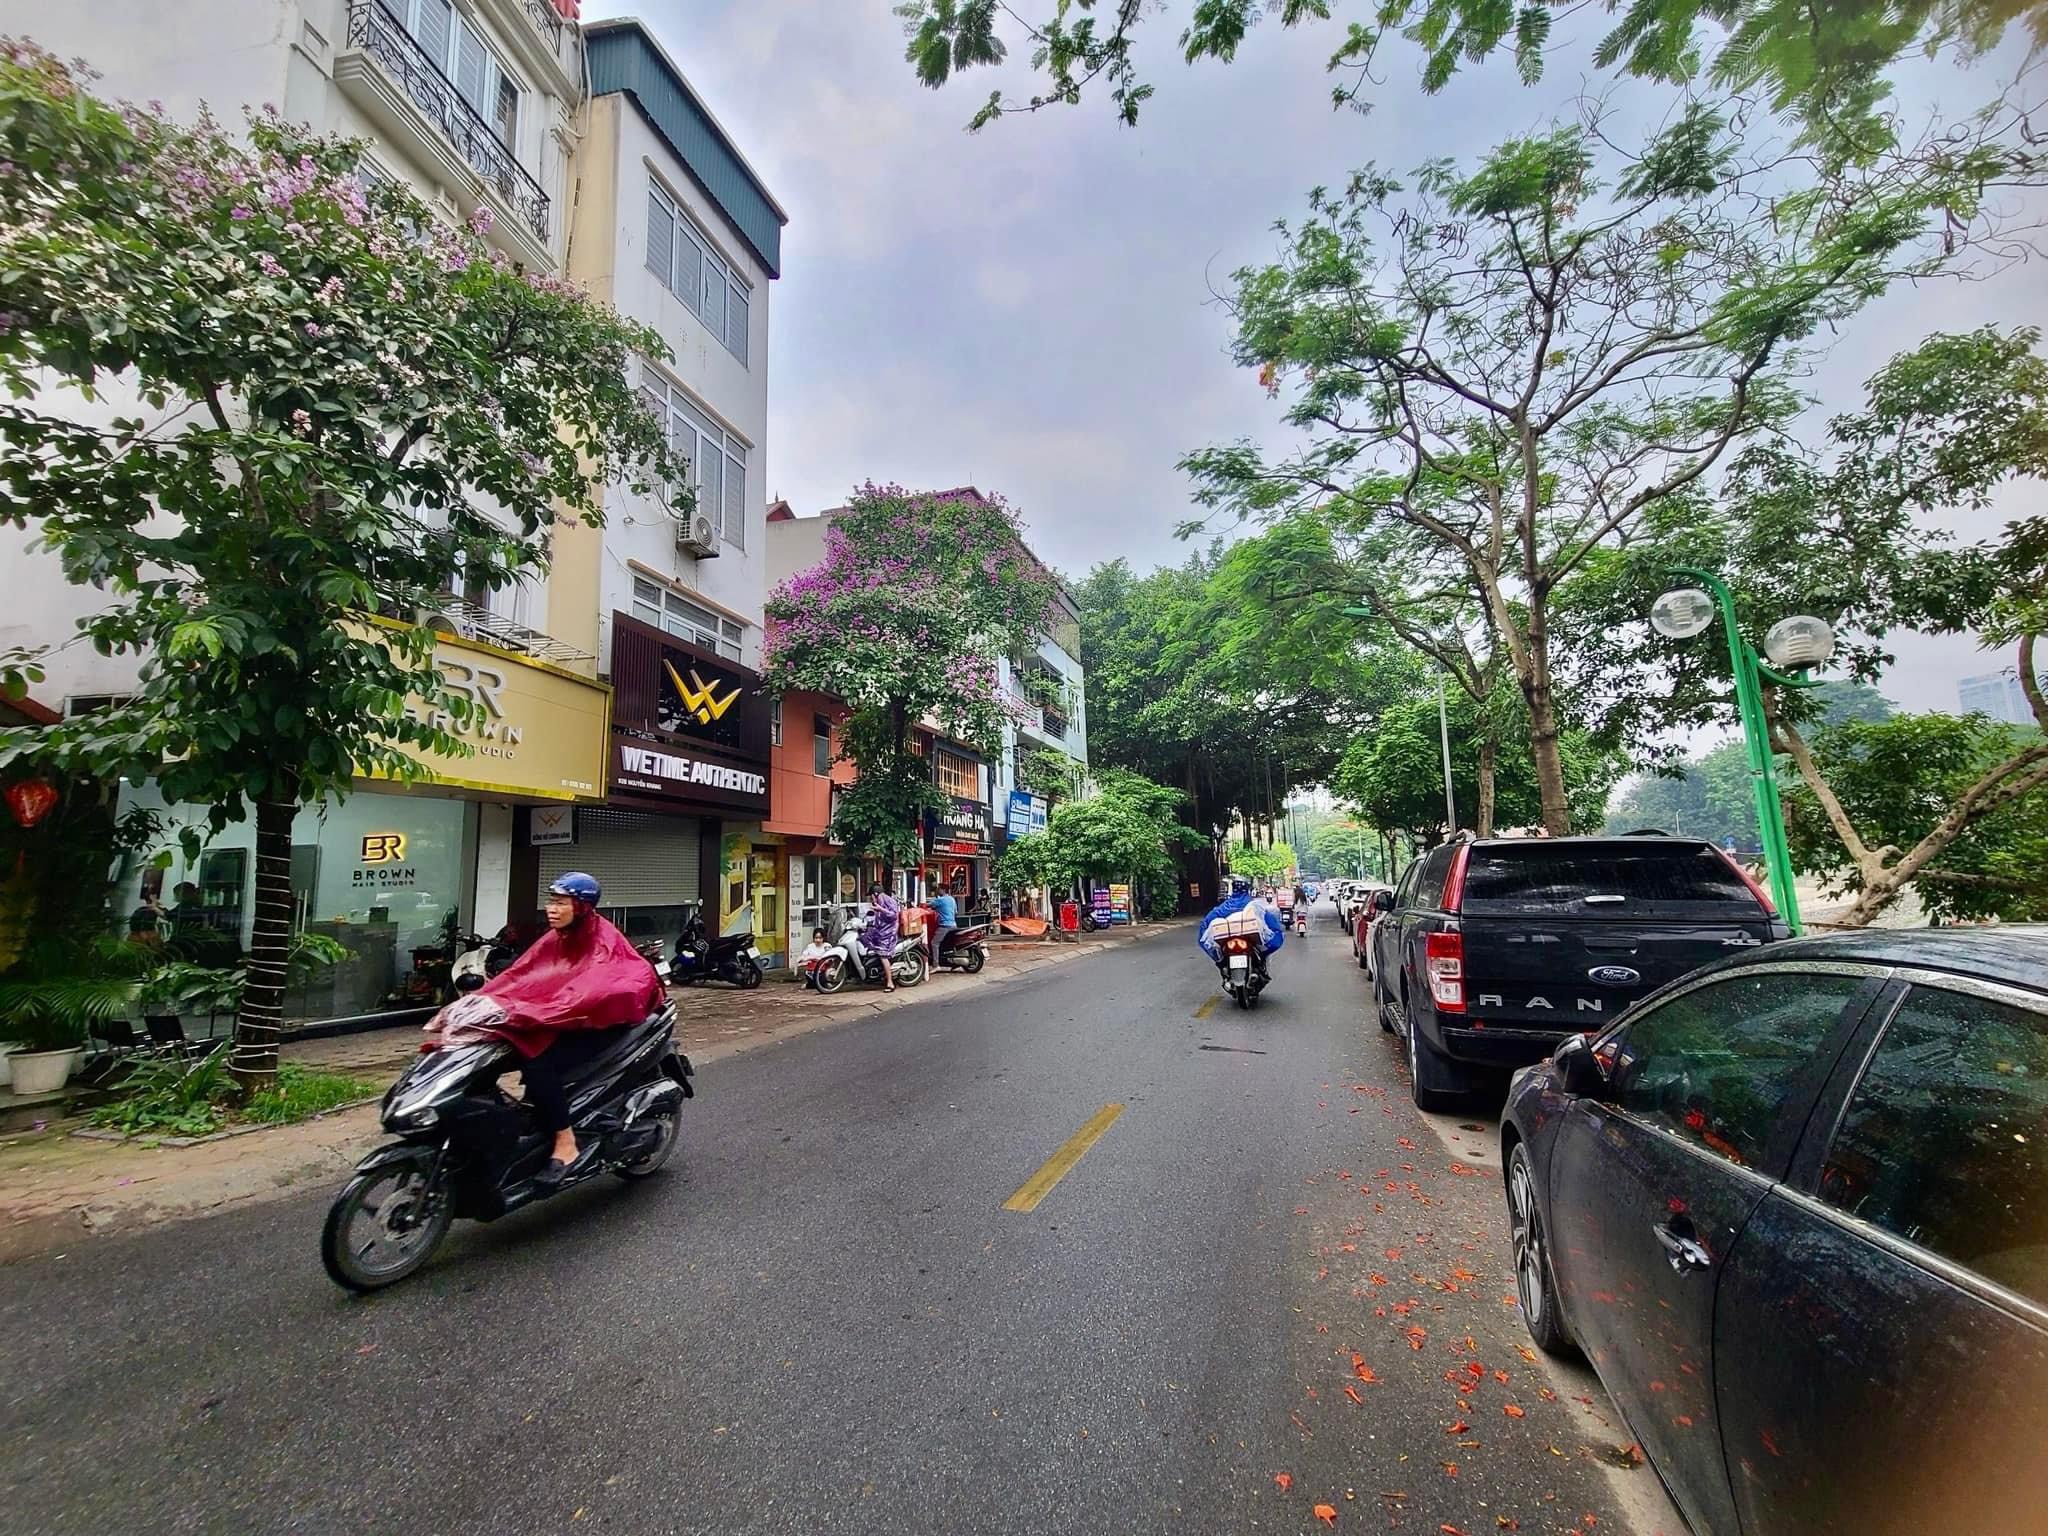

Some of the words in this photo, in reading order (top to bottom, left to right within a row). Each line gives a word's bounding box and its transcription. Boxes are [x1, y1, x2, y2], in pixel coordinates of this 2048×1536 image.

[620, 745, 690, 782] WETIME
[690, 761, 766, 795] AUTHENTIC
[360, 834, 402, 862] BR
[353, 868, 415, 881] BROWN
[1479, 993, 1640, 1013] RAN
